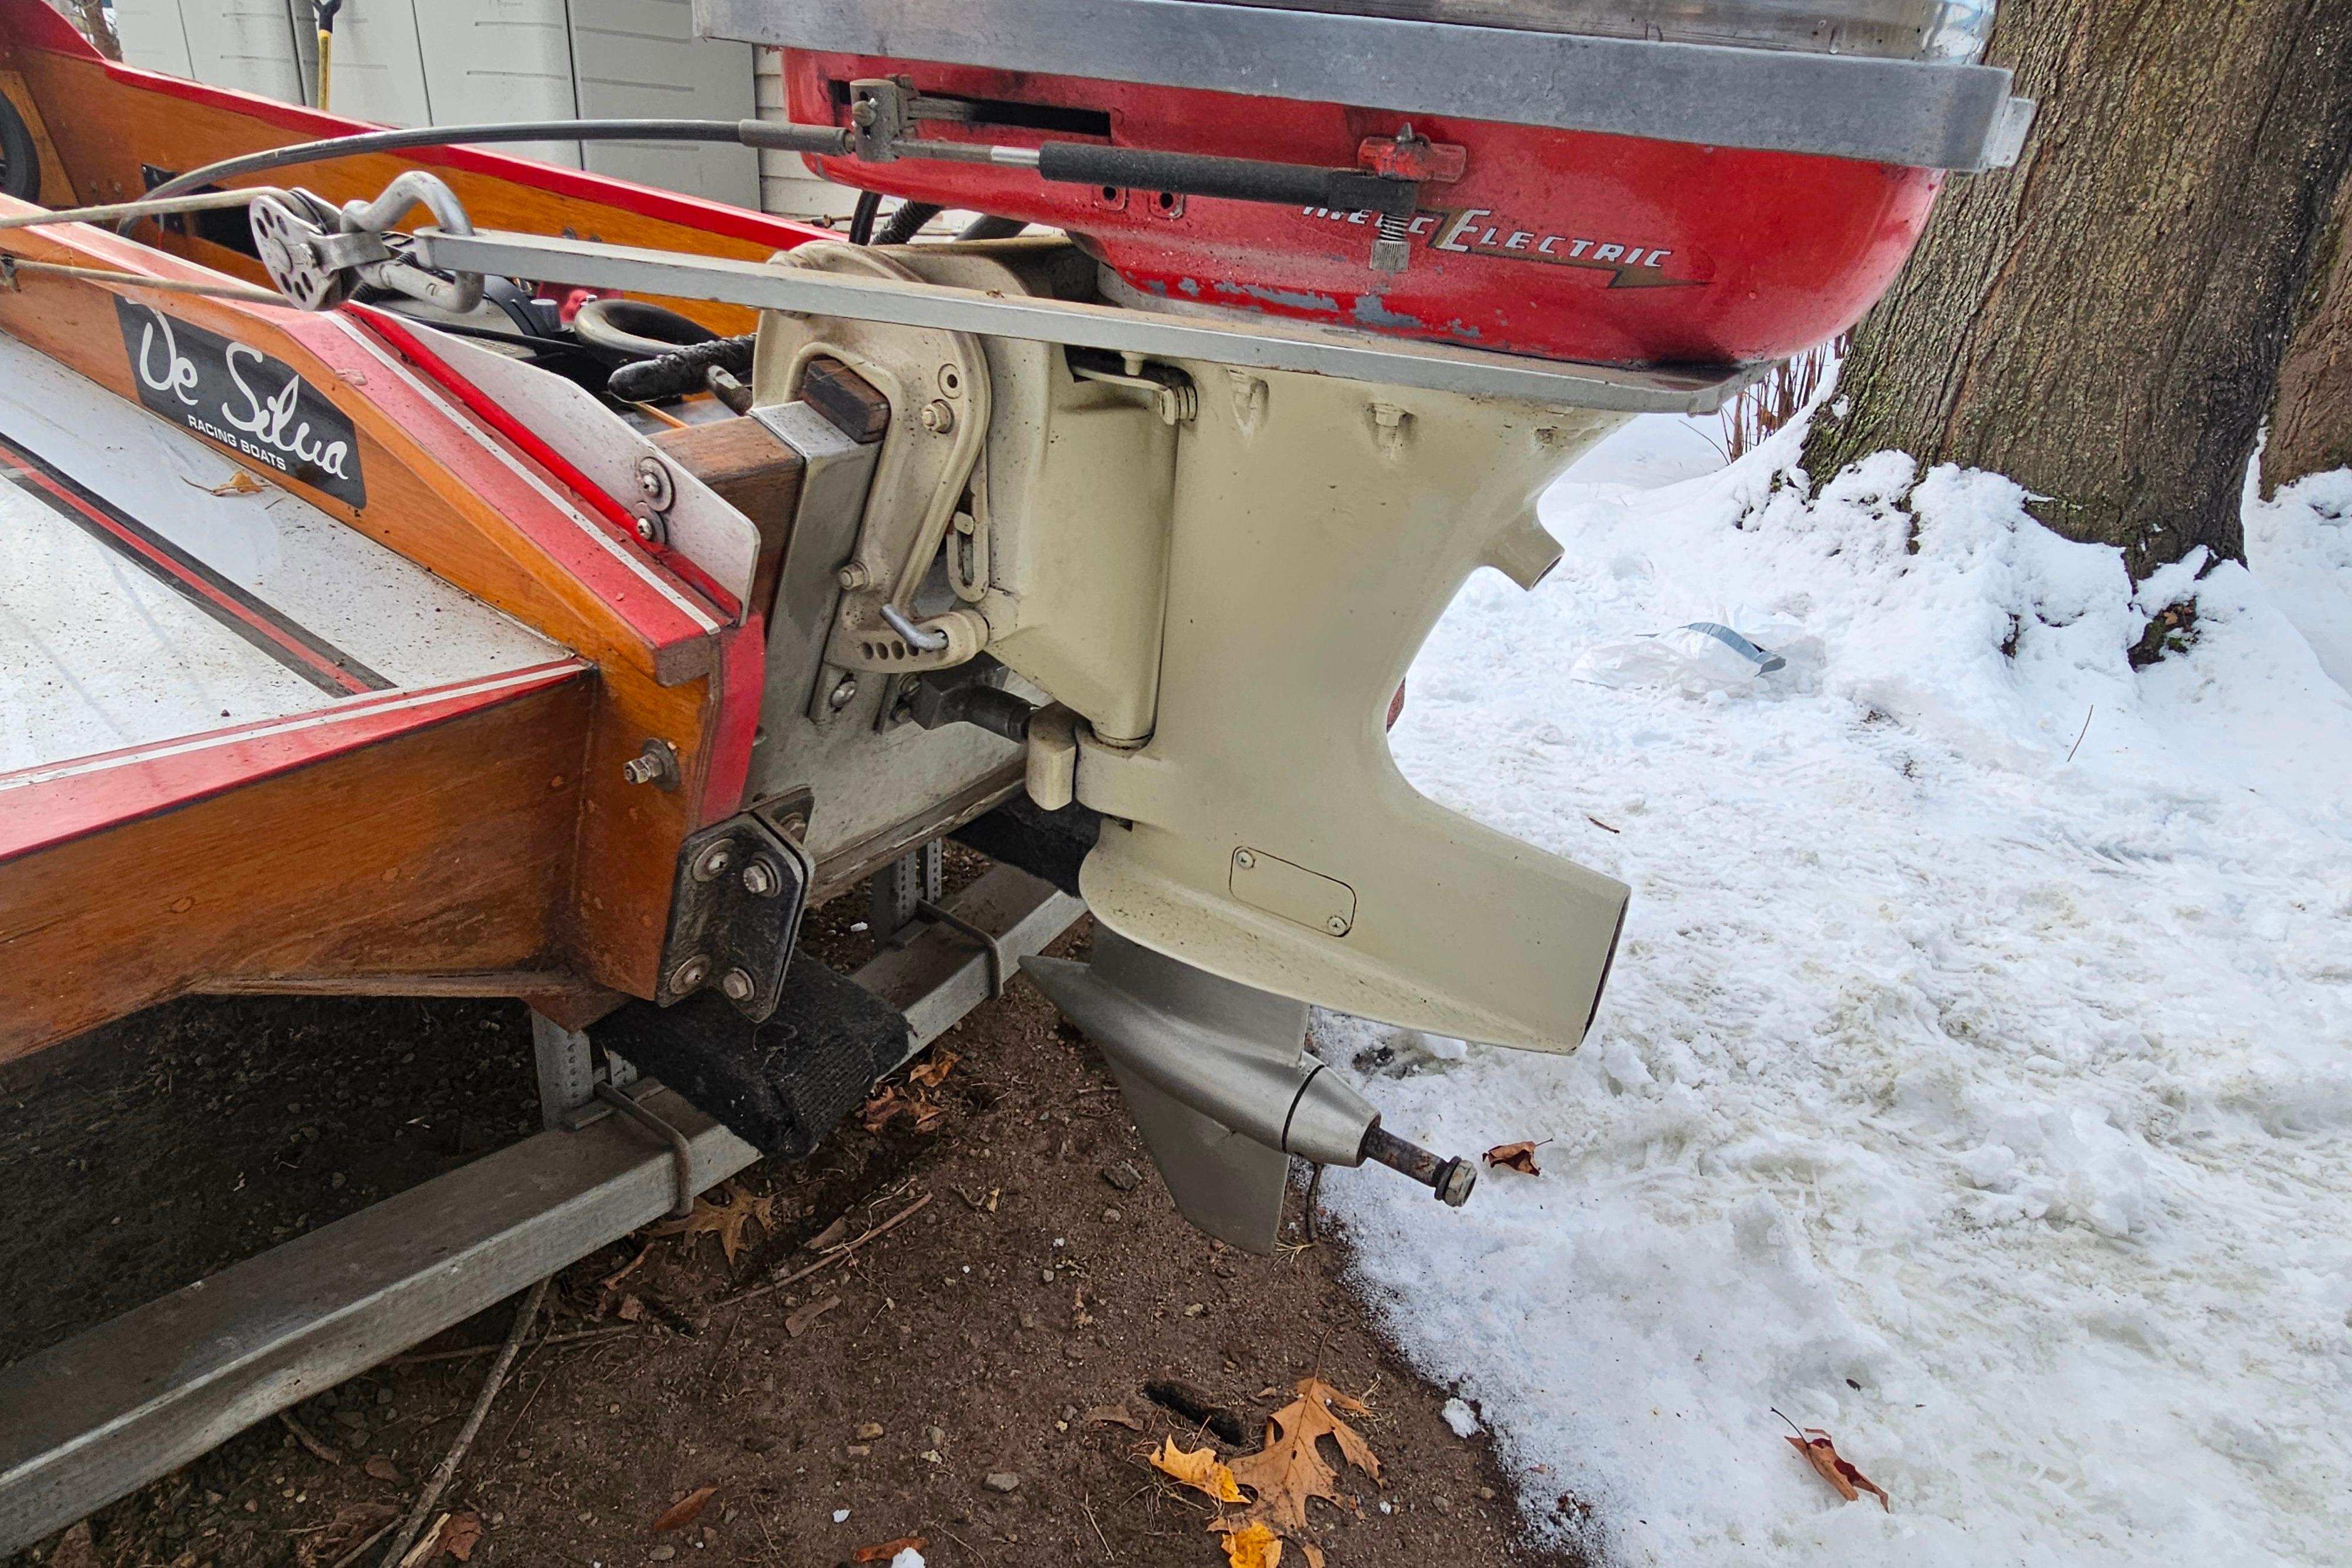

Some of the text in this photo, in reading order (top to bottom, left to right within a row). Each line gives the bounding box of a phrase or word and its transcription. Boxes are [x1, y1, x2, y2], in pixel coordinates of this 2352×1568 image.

[1303, 206, 1672, 268] EC ELECTRIC
[222, 342, 349, 480] Silva
[187, 414, 286, 471] RACING BOATS
